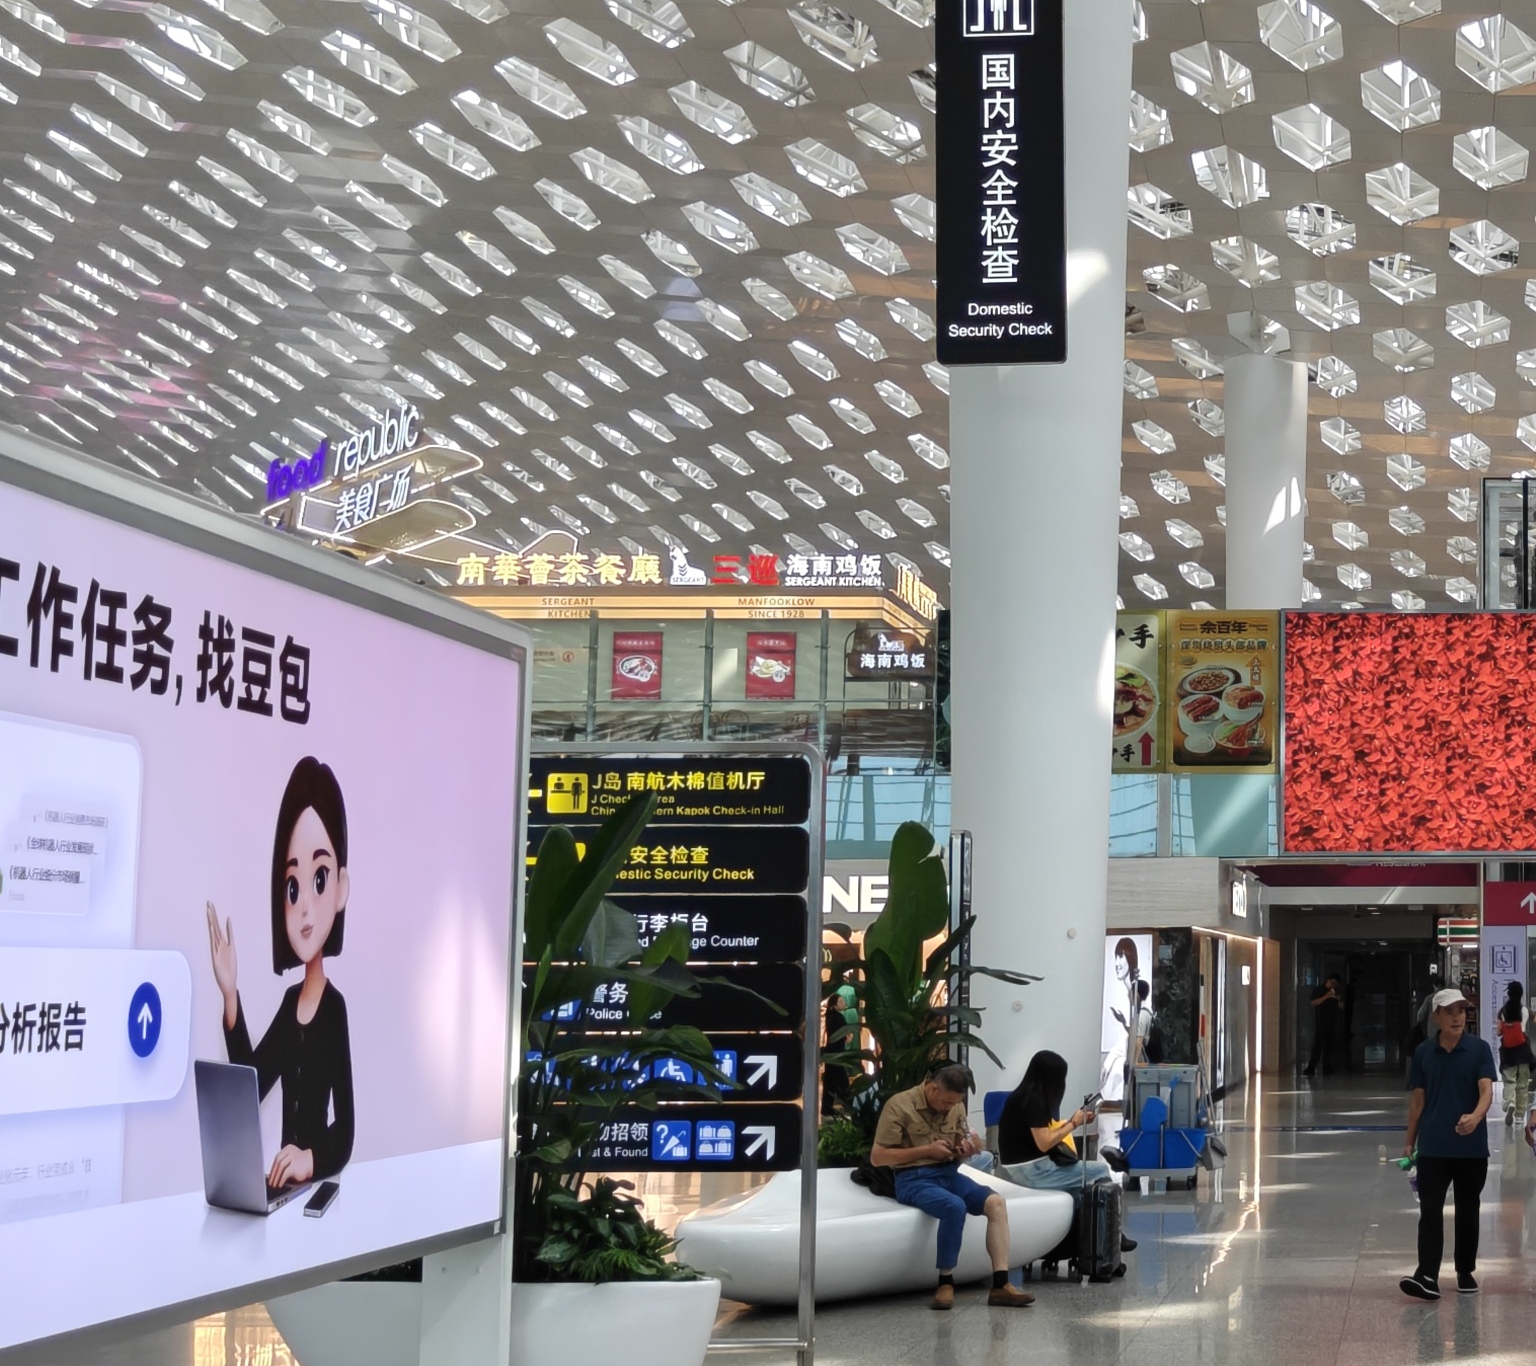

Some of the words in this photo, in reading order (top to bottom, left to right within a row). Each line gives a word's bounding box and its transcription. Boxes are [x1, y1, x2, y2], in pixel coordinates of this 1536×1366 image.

[980, 53, 1019, 283] 国内安全检查
[967, 301, 1033, 317] Domestic
[948, 322, 1005, 341] Security
[1008, 321, 1053, 337] Check
[267, 438, 328, 502] food
[334, 406, 420, 477] republic
[334, 464, 414, 532] 美食广场
[456, 552, 664, 586] 南華薈茶餐廳
[711, 554, 779, 586] 三巡
[786, 553, 882, 576] 海南鸡饭
[785, 576, 836, 586] SERGEANT
[541, 597, 595, 606] SERGEANT
[737, 597, 815, 607] MANFOOKLOW
[547, 609, 592, 618] KITCHEN
[748, 609, 778, 618] SINCE
[780, 609, 805, 618] 1928
[1200, 620, 1248, 634] 余百年
[860, 653, 927, 670] 海南鸡饭
[592, 772, 622, 791] J岛
[627, 771, 766, 792] 南航木棉值机厅
[591, 795, 598, 804] J
[600, 794, 631, 804] Chec
[591, 806, 617, 816] Chin
[676, 806, 711, 817] Kapok
[712, 805, 760, 816] Check-in
[763, 804, 784, 815] Hall
[624, 845, 710, 864] 安全检查
[615, 868, 651, 880] estic
[654, 868, 709, 883] Security
[712, 868, 755, 880] Check
[711, 935, 759, 947] Counter
[603, 1147, 612, 1157] &
[615, 1146, 649, 1158] Found
